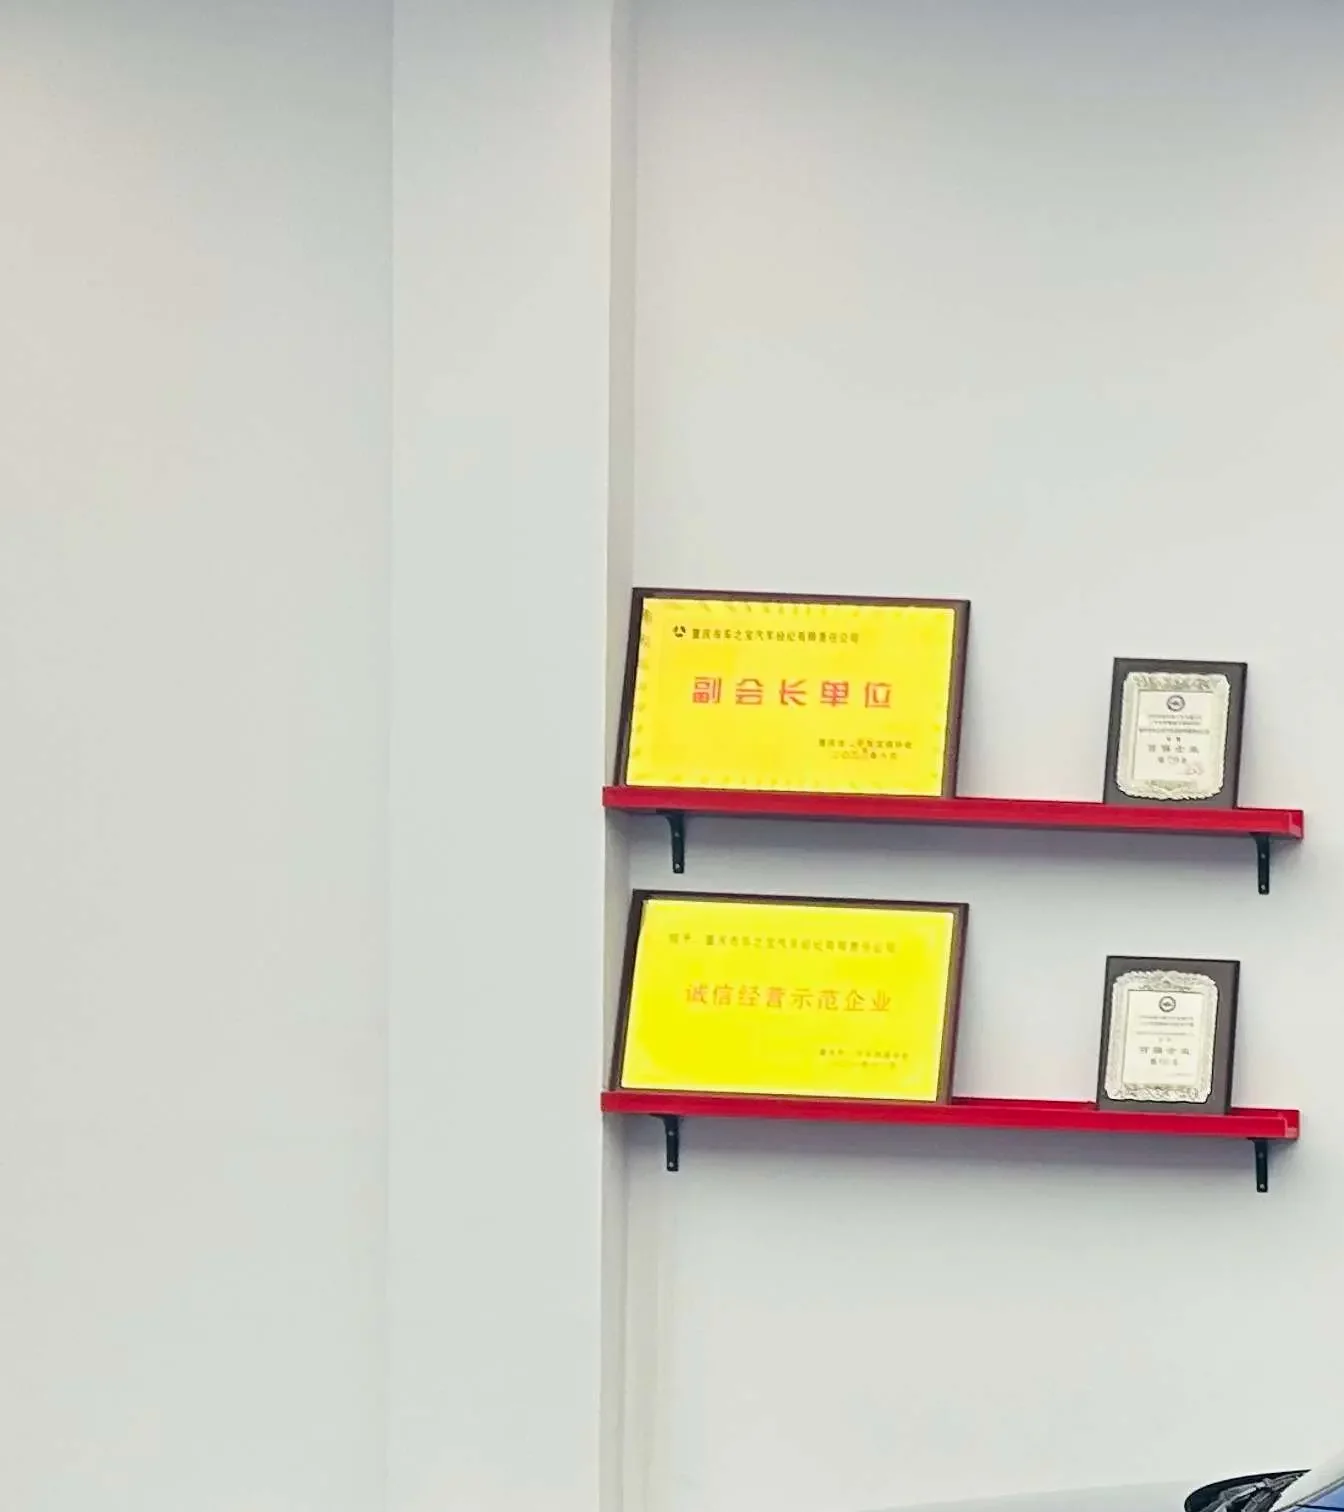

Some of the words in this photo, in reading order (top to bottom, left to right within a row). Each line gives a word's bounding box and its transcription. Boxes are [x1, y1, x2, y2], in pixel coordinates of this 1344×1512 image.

[692, 676, 892, 708] 副会长单位
[685, 983, 893, 1013] 诚信经营示范企业
